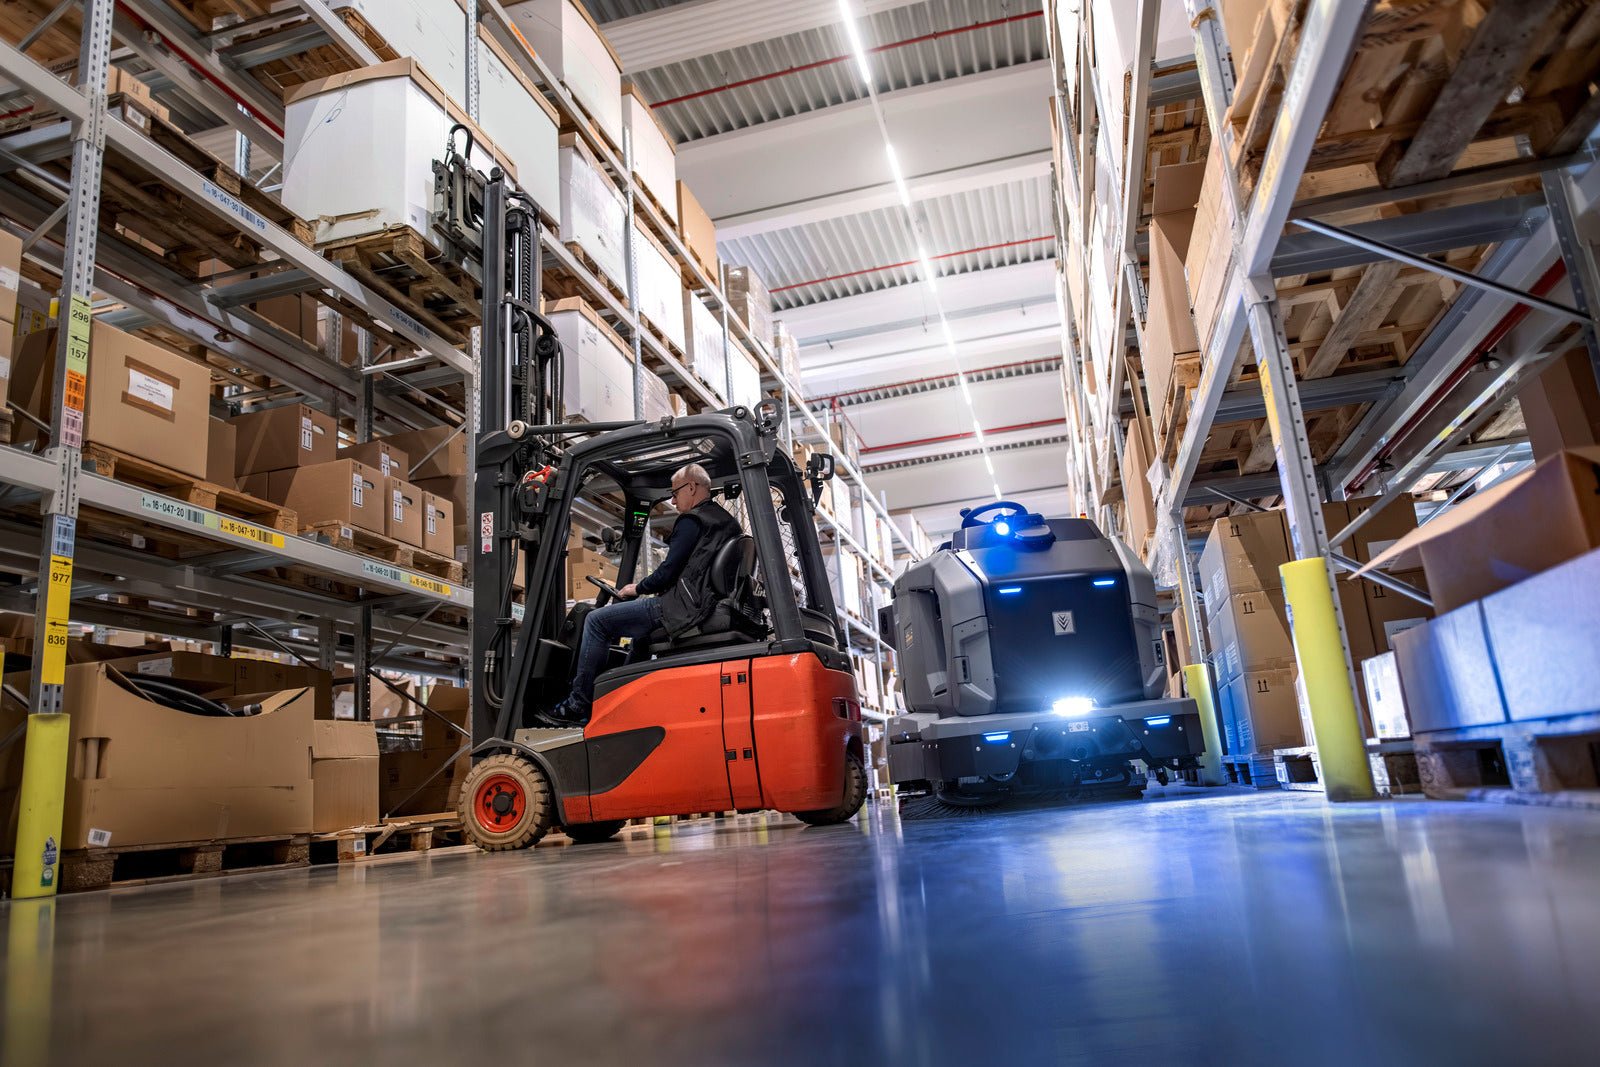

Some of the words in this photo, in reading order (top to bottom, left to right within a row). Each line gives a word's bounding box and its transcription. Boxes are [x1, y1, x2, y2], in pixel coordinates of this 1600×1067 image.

[72, 309, 89, 323] 298
[71, 347, 87, 360] 157
[152, 500, 185, 518] 16-047-20
[229, 522, 256, 538] 16-047-10
[52, 572, 70, 583] 977
[47, 634, 66, 646] 836
